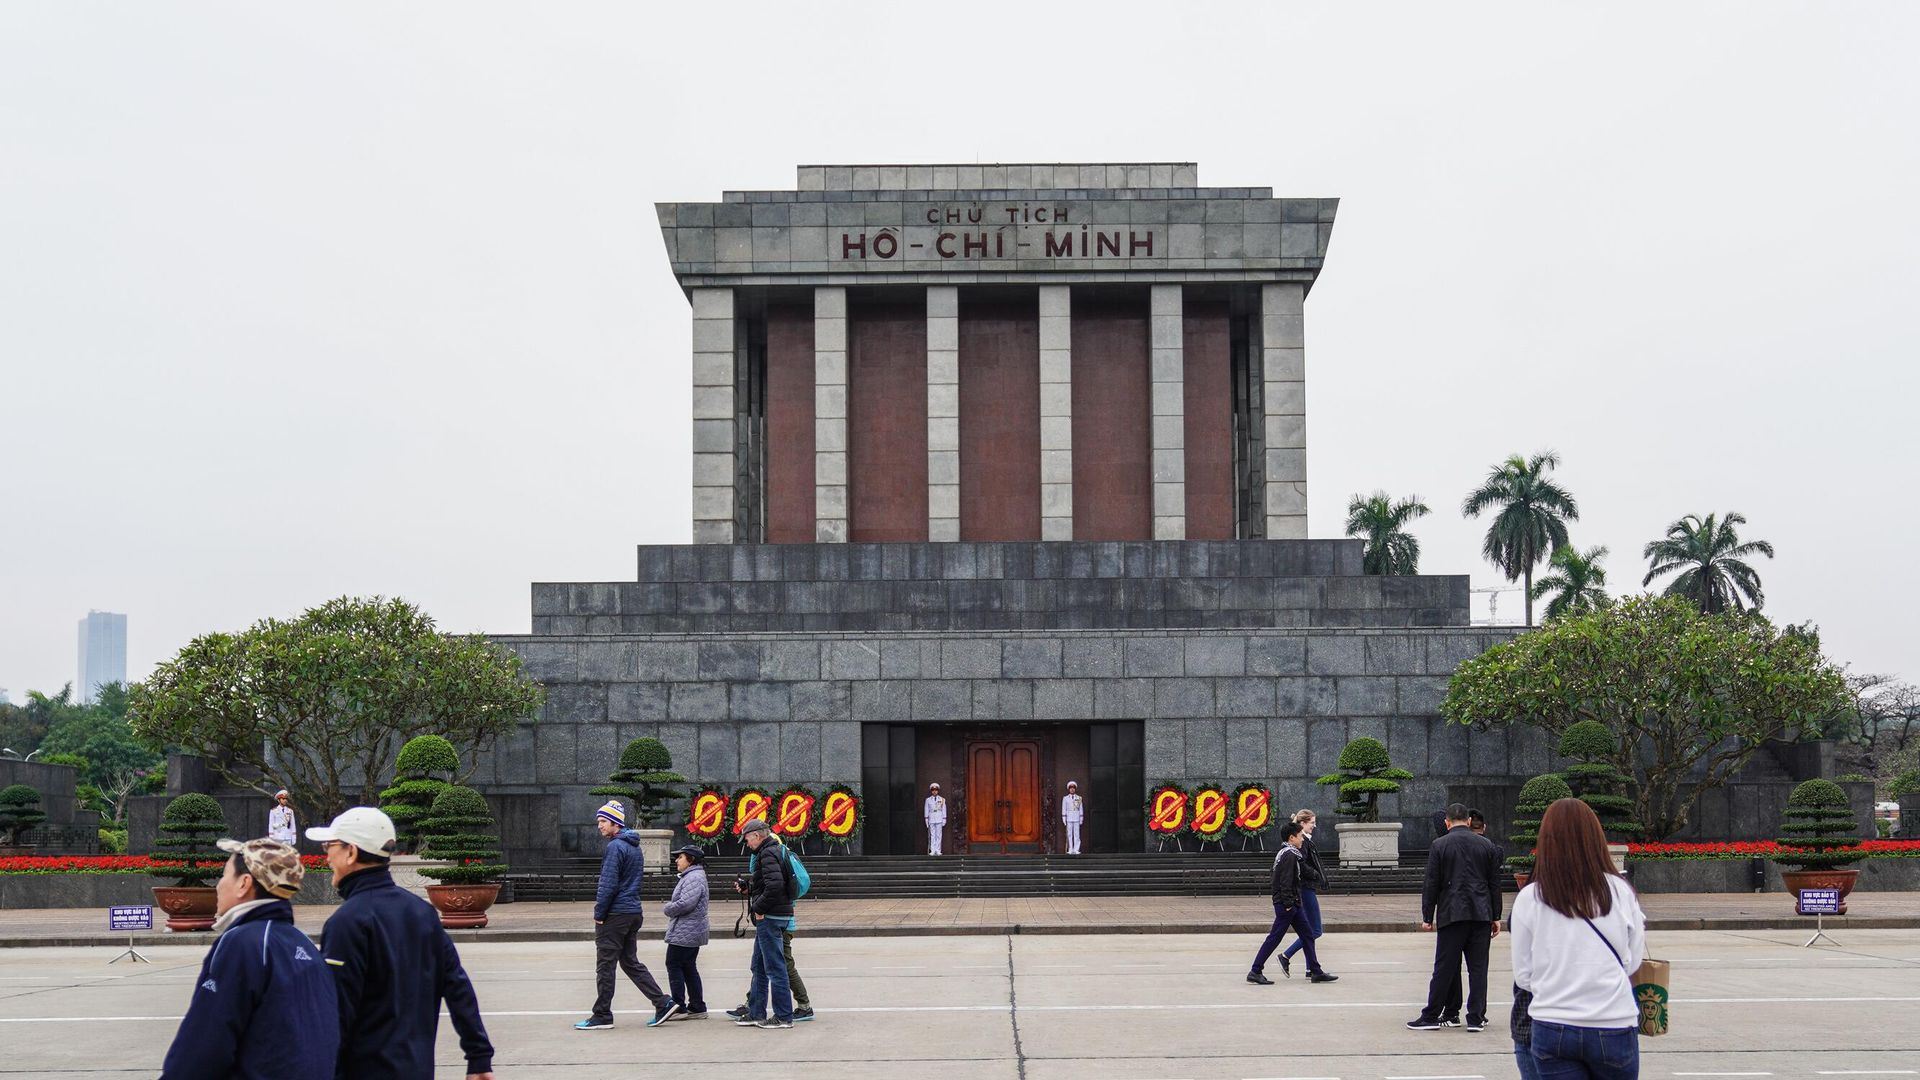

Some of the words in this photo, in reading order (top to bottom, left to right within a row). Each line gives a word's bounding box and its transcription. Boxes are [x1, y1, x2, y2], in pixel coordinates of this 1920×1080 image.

[927, 202, 982, 224] CHỦ
[842, 227, 899, 258] HỒ
[936, 226, 1006, 258] CHÍ
